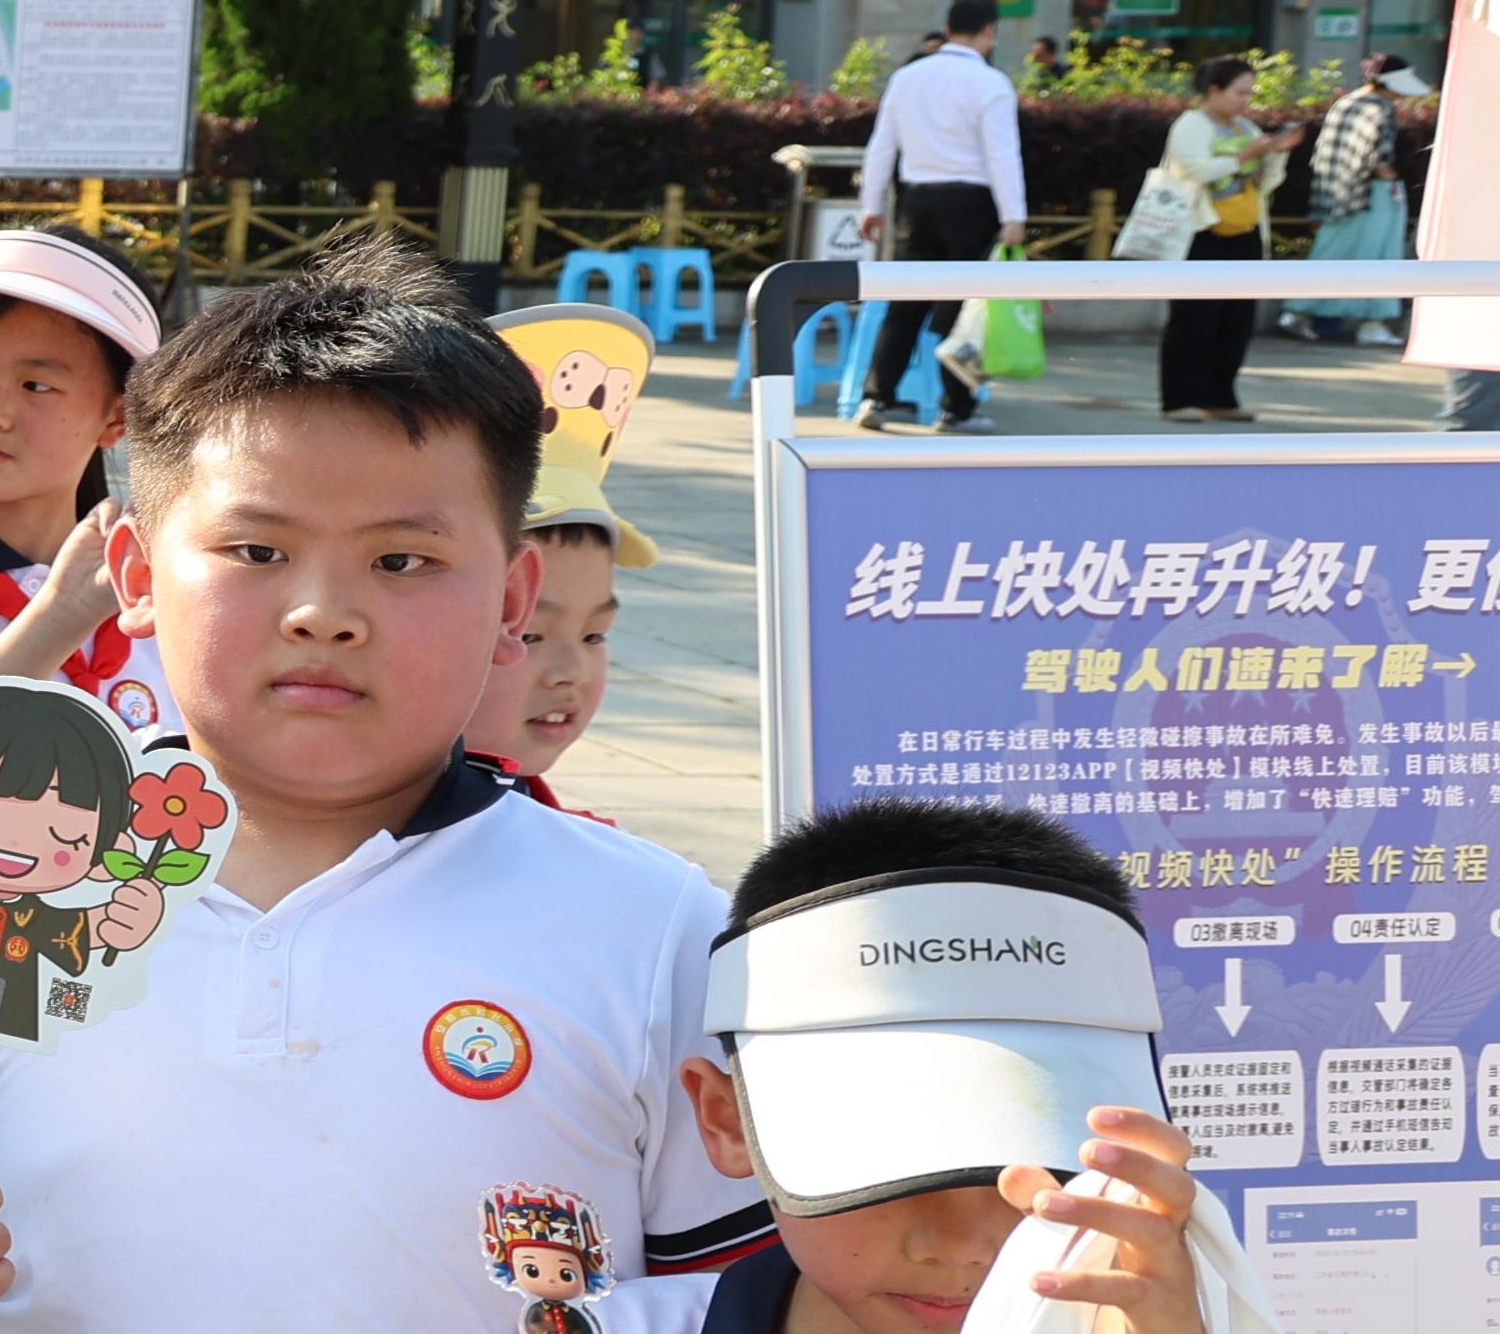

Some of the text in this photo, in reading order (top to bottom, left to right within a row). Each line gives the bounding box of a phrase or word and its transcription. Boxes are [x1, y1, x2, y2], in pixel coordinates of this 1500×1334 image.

[844, 537, 1378, 620] 线上快处再升级！
[1020, 643, 1429, 693] 驾驶人们速来了解
[1323, 842, 1490, 886] 操作流程
[1349, 917, 1441, 940] 04责任认定
[859, 936, 1067, 968] DINGSHANG
